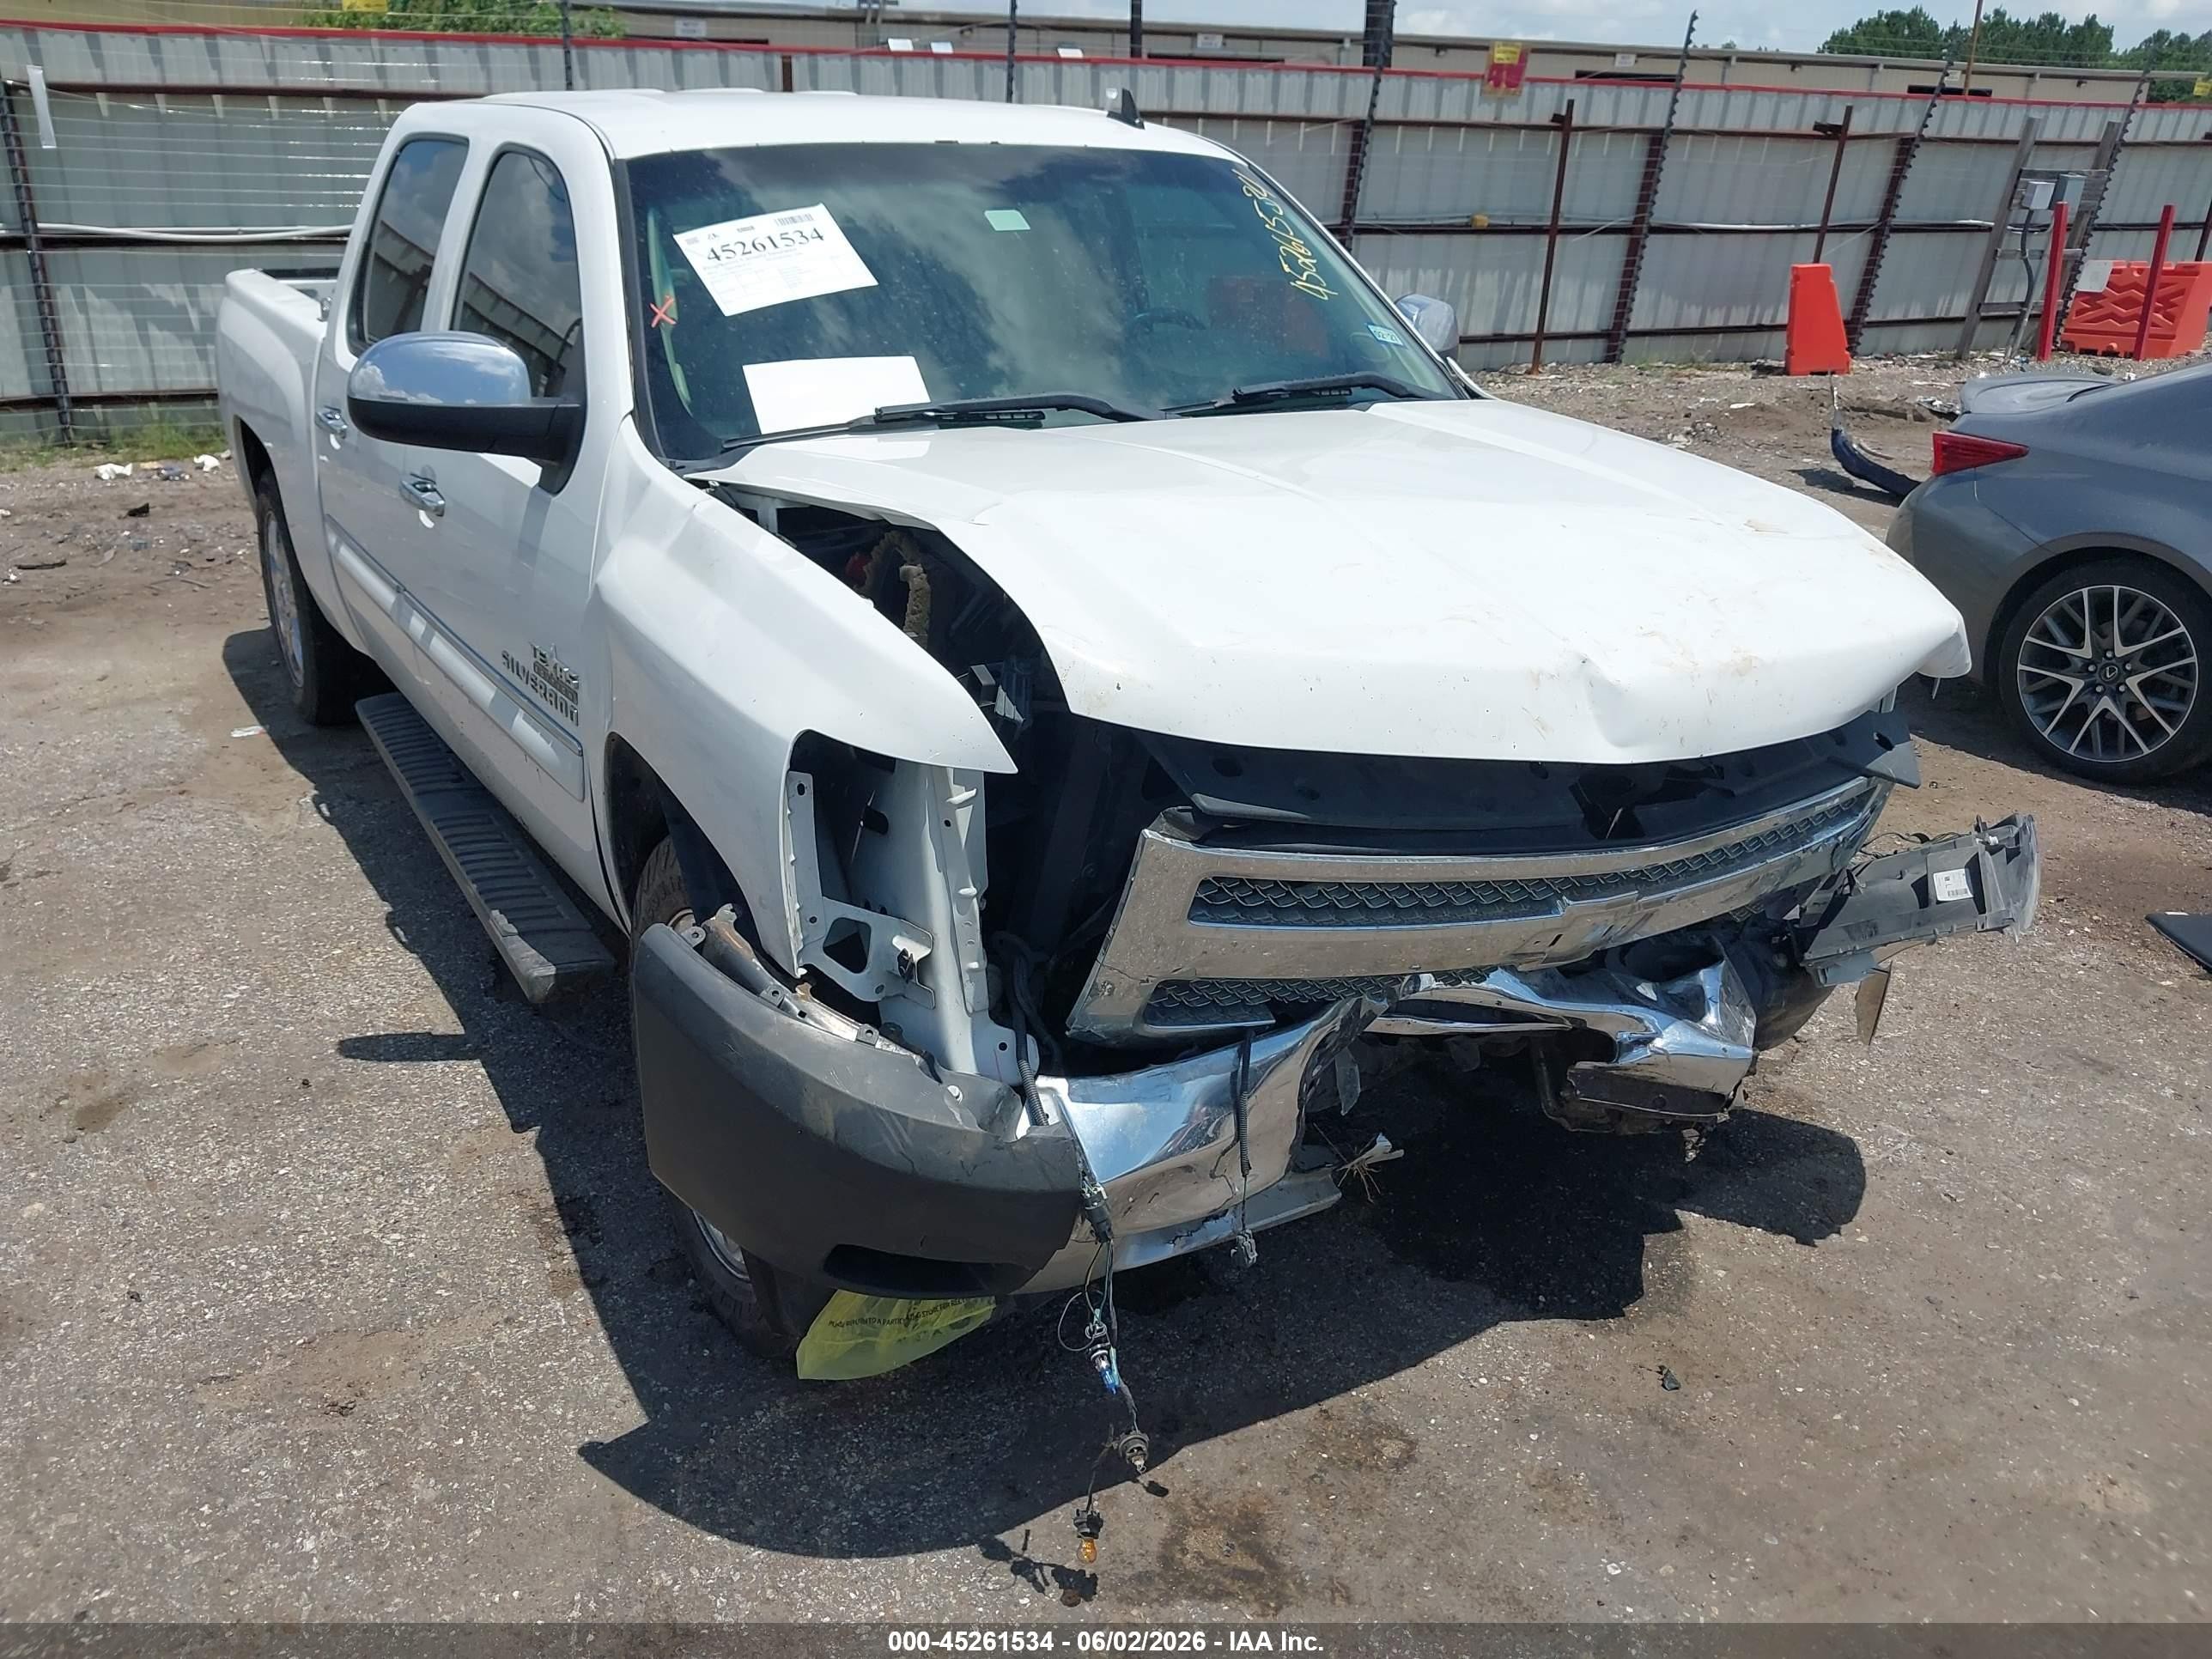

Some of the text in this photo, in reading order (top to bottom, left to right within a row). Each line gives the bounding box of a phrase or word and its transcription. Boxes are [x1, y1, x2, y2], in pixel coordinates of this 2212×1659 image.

[707, 226, 825, 262] 45261534
[1231, 168, 1340, 301] 45261534
[501, 649, 580, 726] SILVERADO
[529, 644, 580, 690] TEXAS
